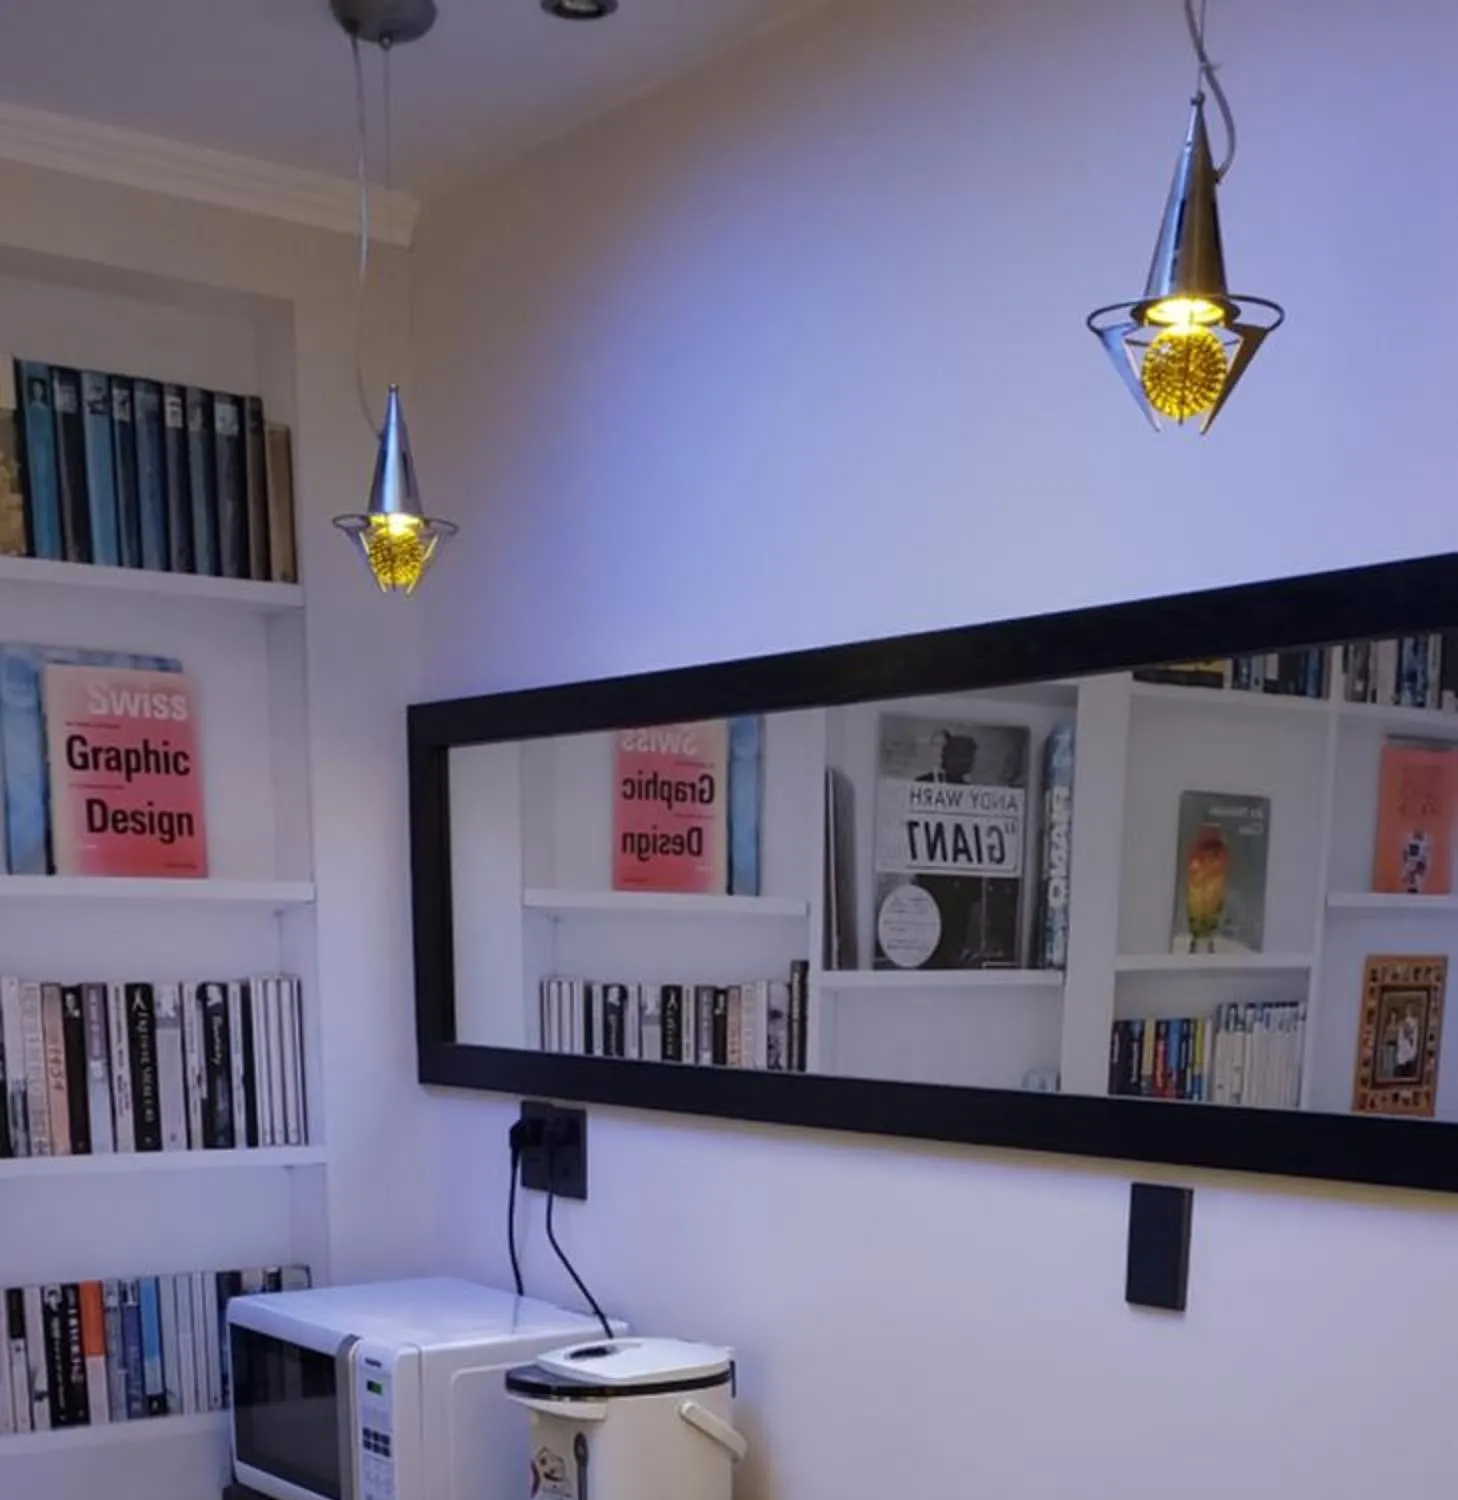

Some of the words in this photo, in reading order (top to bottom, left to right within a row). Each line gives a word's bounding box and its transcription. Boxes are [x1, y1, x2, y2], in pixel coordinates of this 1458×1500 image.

[86, 681, 188, 721] Swiss
[65, 734, 191, 783] Graphic
[85, 798, 195, 844] Design
